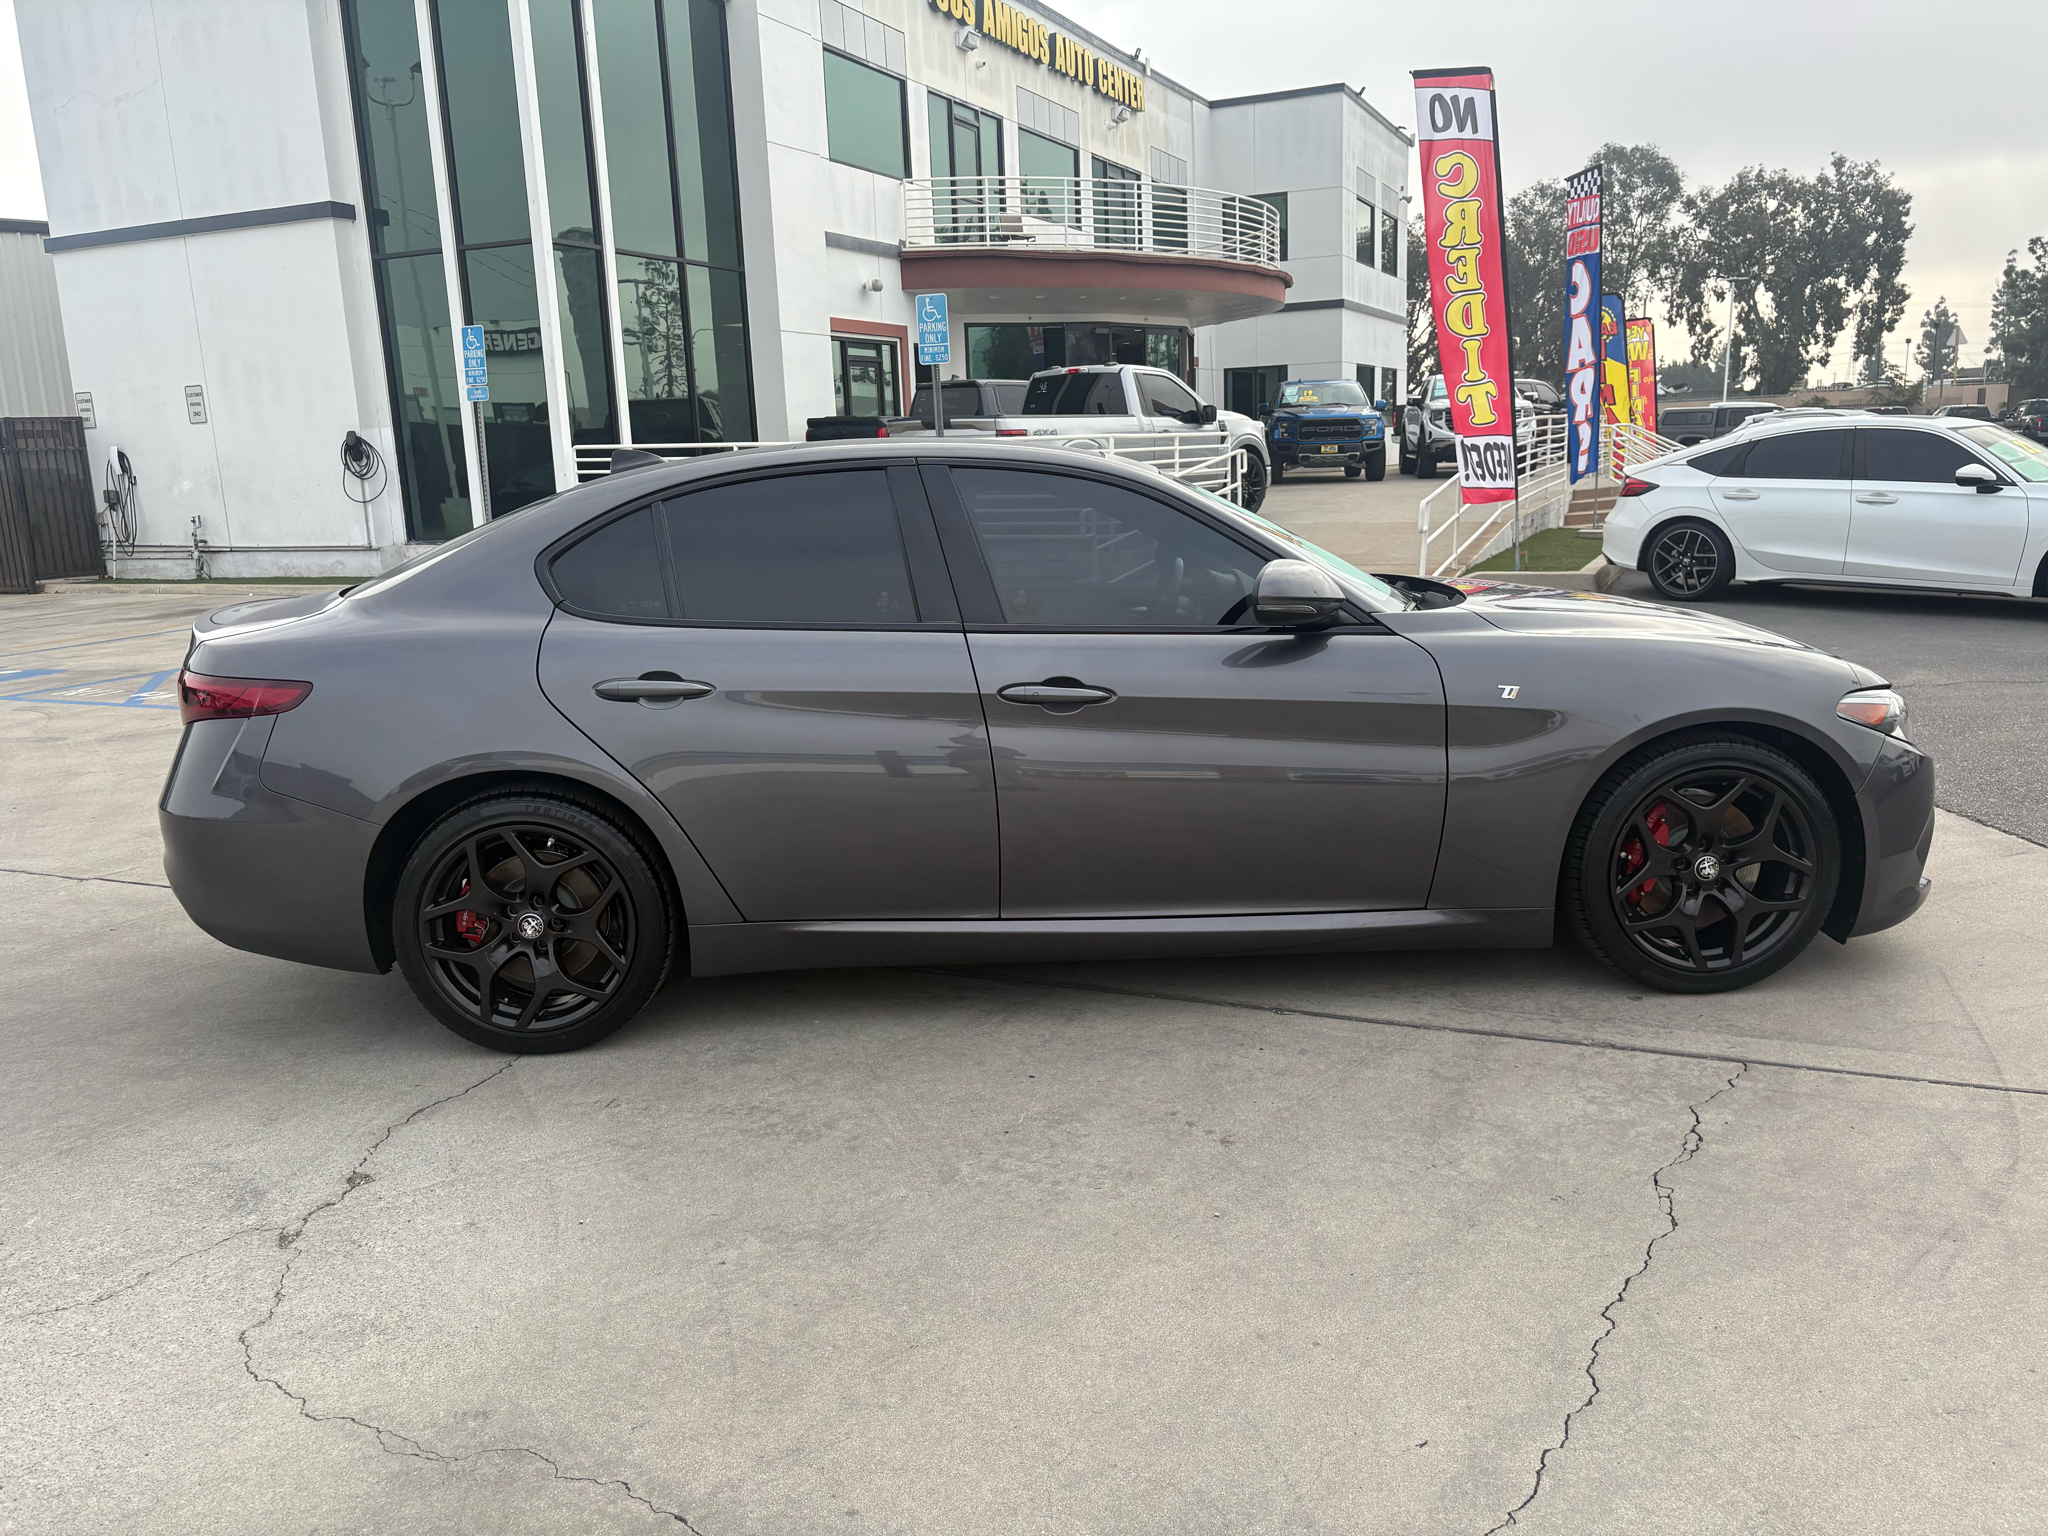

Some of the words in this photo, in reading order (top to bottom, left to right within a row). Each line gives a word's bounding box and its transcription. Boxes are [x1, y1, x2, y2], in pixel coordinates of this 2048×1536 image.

[983, 0, 1050, 65] AMIGOS
[1055, 33, 1094, 86] AUTO
[1098, 57, 1146, 112] CENTER
[919, 322, 947, 333] PARKING
[925, 333, 942, 344] ONLY
[464, 349, 484, 359] PARKING
[924, 346, 945, 354] MINIMUM
[921, 354, 932, 362] FINE
[934, 353, 948, 362] $250
[468, 359, 481, 368] ONLY
[1302, 425, 1360, 433] FORD
